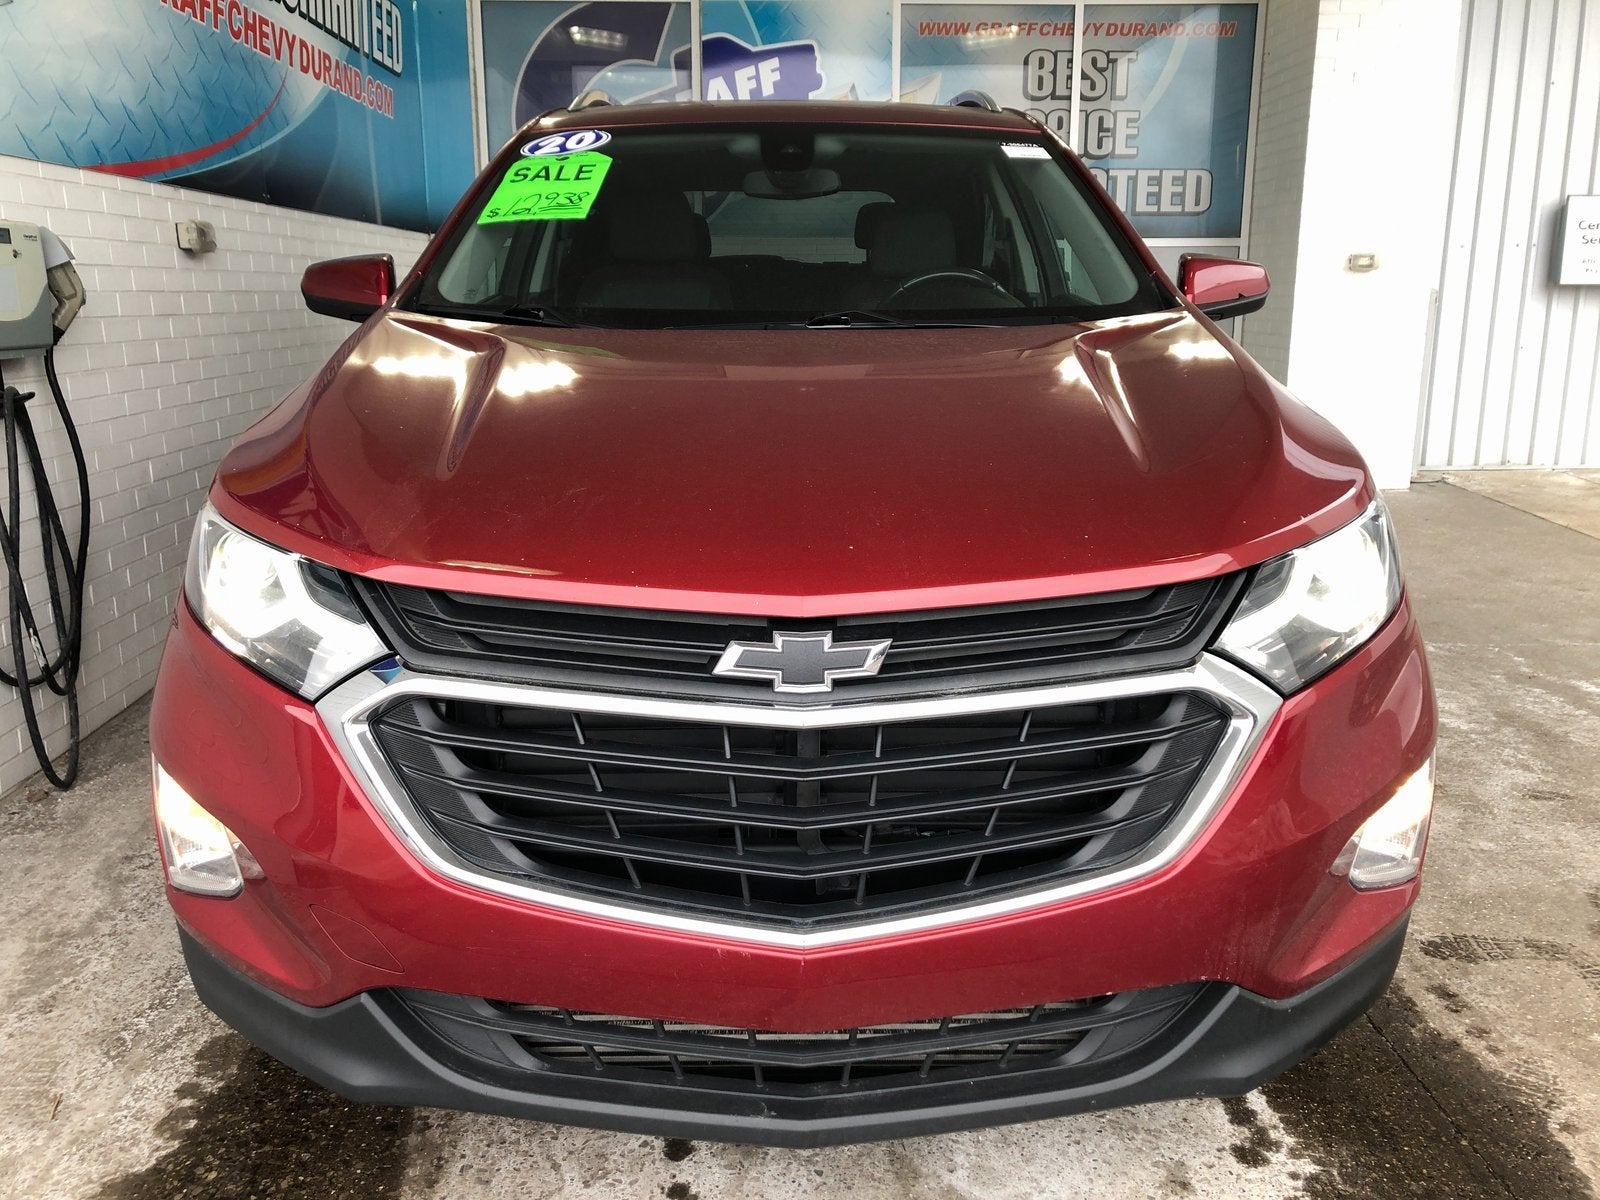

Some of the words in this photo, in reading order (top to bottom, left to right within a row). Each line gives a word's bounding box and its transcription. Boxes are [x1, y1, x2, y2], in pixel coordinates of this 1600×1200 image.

[918, 21, 1237, 37] WWWGRAFFCHEVYDURAND.COM
[1022, 49, 1138, 101] BEST
[533, 129, 598, 155] 20
[510, 163, 596, 183] SALE
